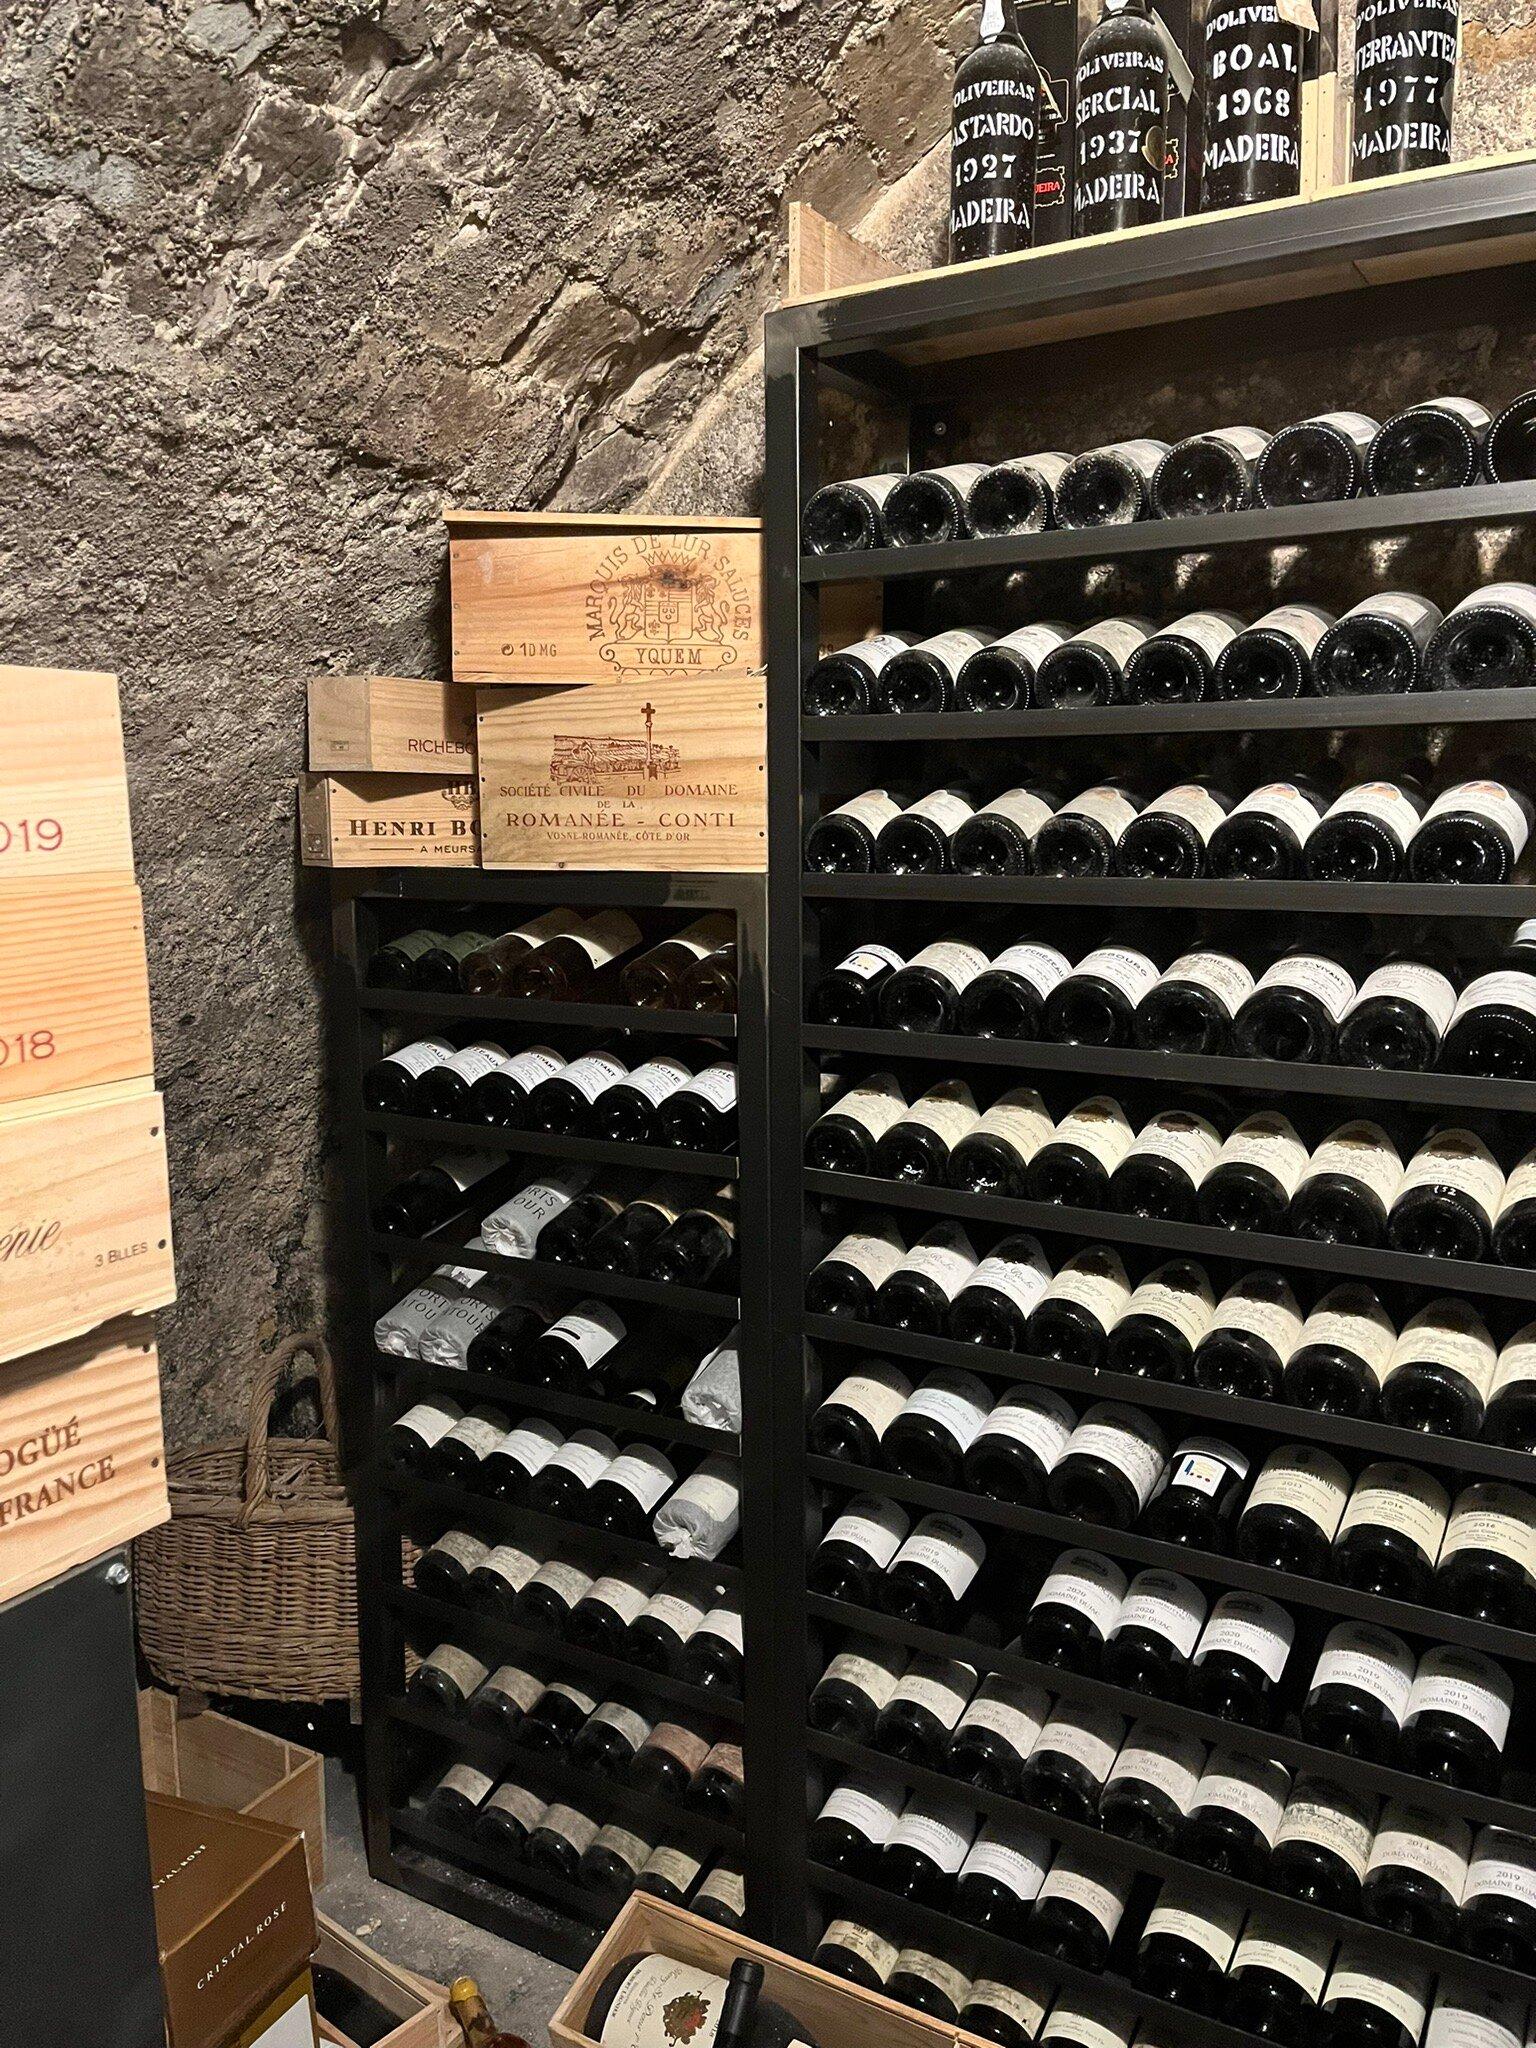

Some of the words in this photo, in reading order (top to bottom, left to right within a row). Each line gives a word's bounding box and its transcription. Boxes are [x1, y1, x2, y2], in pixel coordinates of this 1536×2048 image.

[1206, 5, 1279, 41] D'OLIVEI
[1076, 52, 1164, 83] OLIVEIRAS
[1213, 42, 1297, 79] BOAL
[1356, 30, 1457, 76] TERRANTEZ
[954, 79, 1035, 108] OLIVEIRAS
[1076, 86, 1160, 130] SERCIAL
[1217, 86, 1290, 123] 1968
[1364, 76, 1439, 113] 1977
[952, 112, 1034, 150] ASTARDO
[1080, 130, 1141, 165] 1937
[1352, 122, 1451, 161] MADEIRA
[956, 154, 1016, 187] 1927
[1202, 134, 1299, 178] MADEIRA
[586, 547, 628, 641] MARQUIS
[632, 535, 661, 555] DE
[672, 534, 711, 560] LUR
[714, 556, 752, 641] SALUCES
[635, 648, 702, 665] YQUEM
[408, 739, 477, 754] RICHEBO
[500, 783, 551, 797] SOCIÉTÉ
[560, 785, 605, 797] CIVILE
[626, 786, 646, 796] DU
[665, 784, 738, 796] DOMAINE
[597, 800, 611, 809] DE
[622, 800, 635, 809] LA
[350, 819, 436, 836] HENRI
[506, 810, 625, 827] ROMANÉE
[659, 813, 736, 827] CONTI
[420, 846, 428, 854] A
[434, 846, 479, 854] MEURS
[0, 1219, 62, 1262] énie
[95, 1254, 104, 1268] 3
[0, 1415, 82, 1477] OGÜÉ
[0, 1453, 116, 1529] FRANCE
[1356, 1666, 1381, 1680] 2019
[1444, 1689, 1469, 1701] 2019
[1496, 1870, 1521, 1881] 2019
[1514, 1885, 1536, 1900] DUJA
[197, 1936, 255, 1990] CRISTAL
